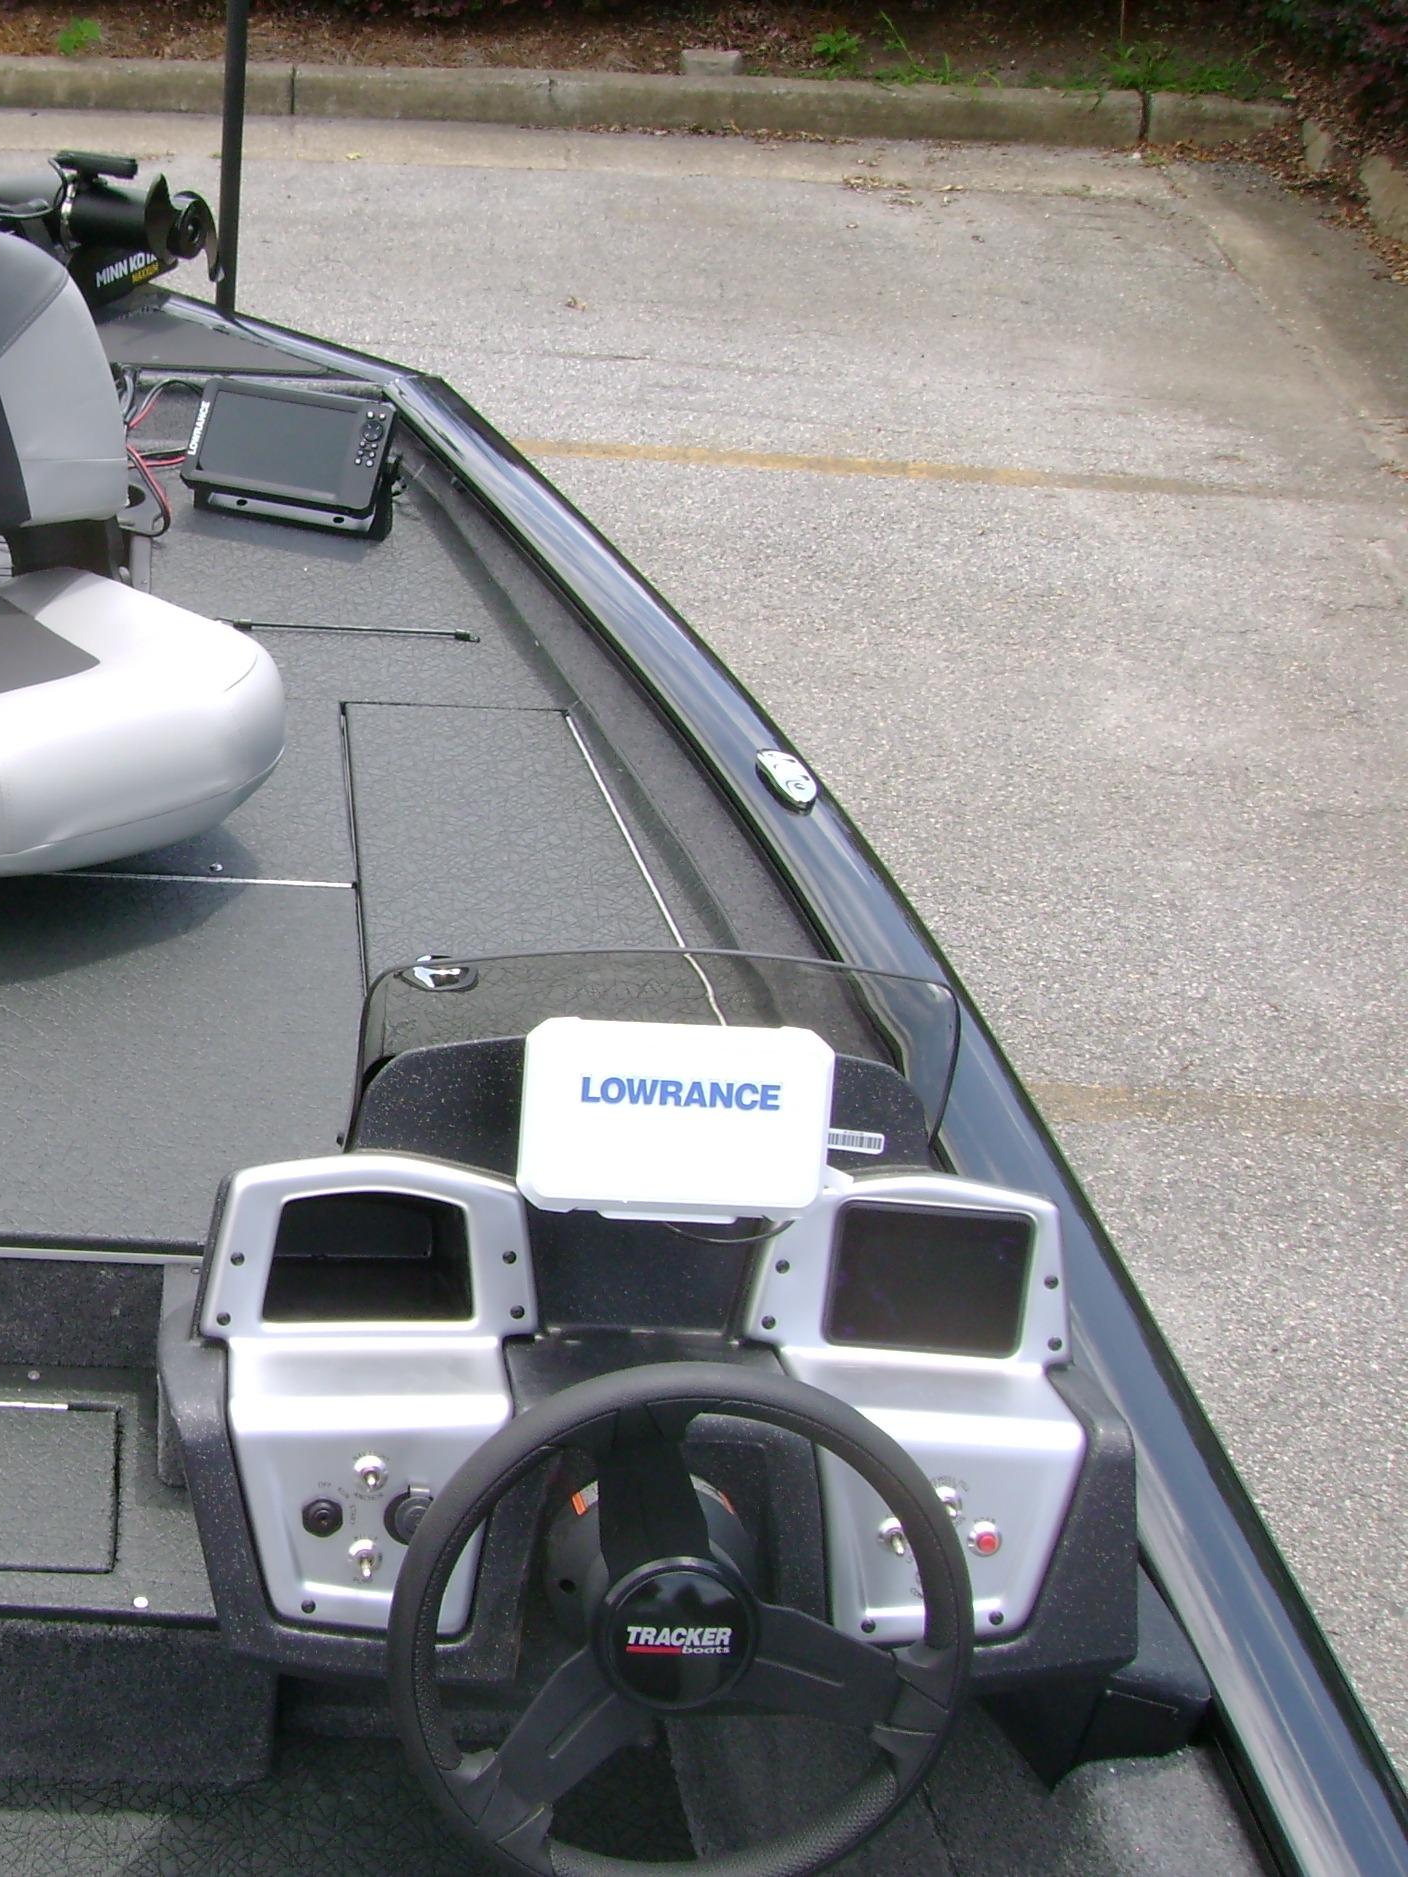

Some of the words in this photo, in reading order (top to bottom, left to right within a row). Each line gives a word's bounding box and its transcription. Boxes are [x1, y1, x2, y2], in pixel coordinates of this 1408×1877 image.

[96, 259, 129, 288] MINN
[188, 400, 211, 455] LOWRANCE
[580, 1076, 782, 1111] LOWRANCE
[626, 1626, 732, 1647] TRACKER
[681, 1646, 731, 1655] boats
